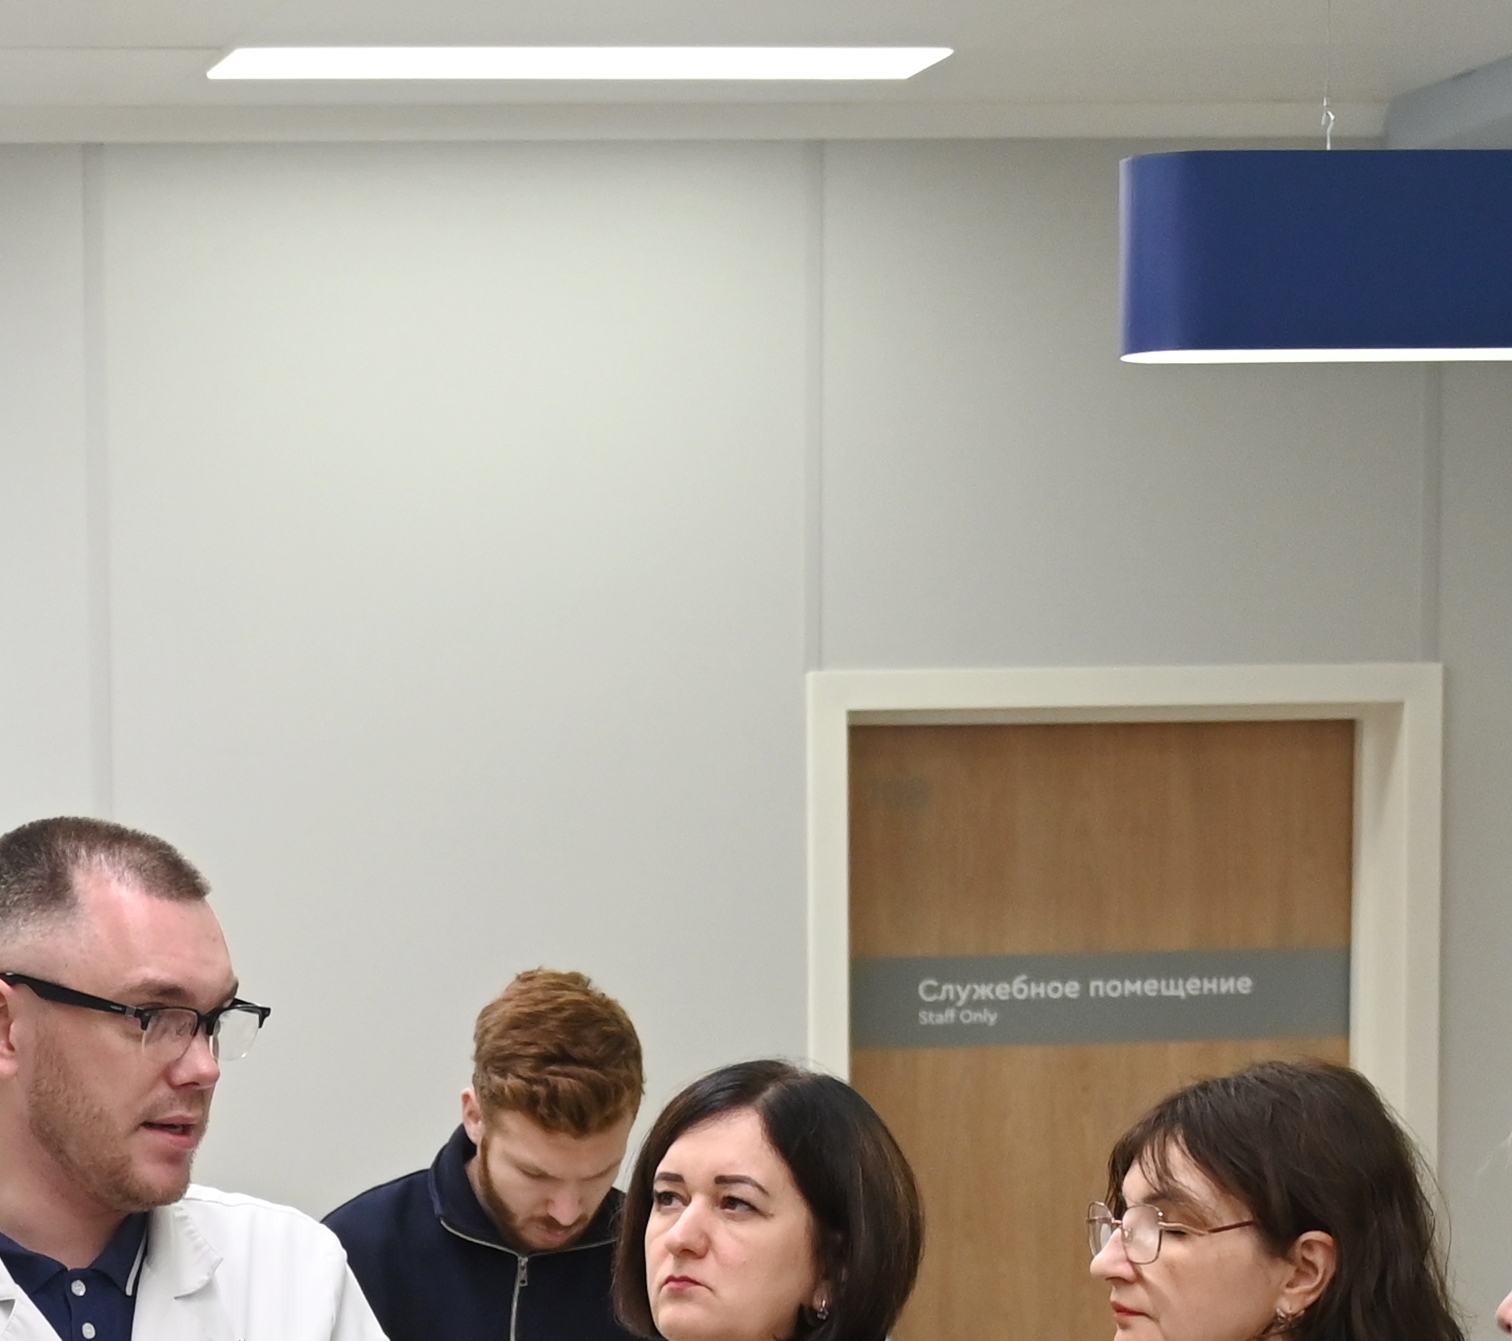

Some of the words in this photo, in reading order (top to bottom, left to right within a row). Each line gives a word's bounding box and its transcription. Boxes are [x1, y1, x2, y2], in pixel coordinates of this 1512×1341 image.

[917, 972, 1081, 1006] Служебное
[1088, 972, 1254, 1000] помещение
[918, 1008, 957, 1026] Staff
[959, 1006, 999, 1028] Only
